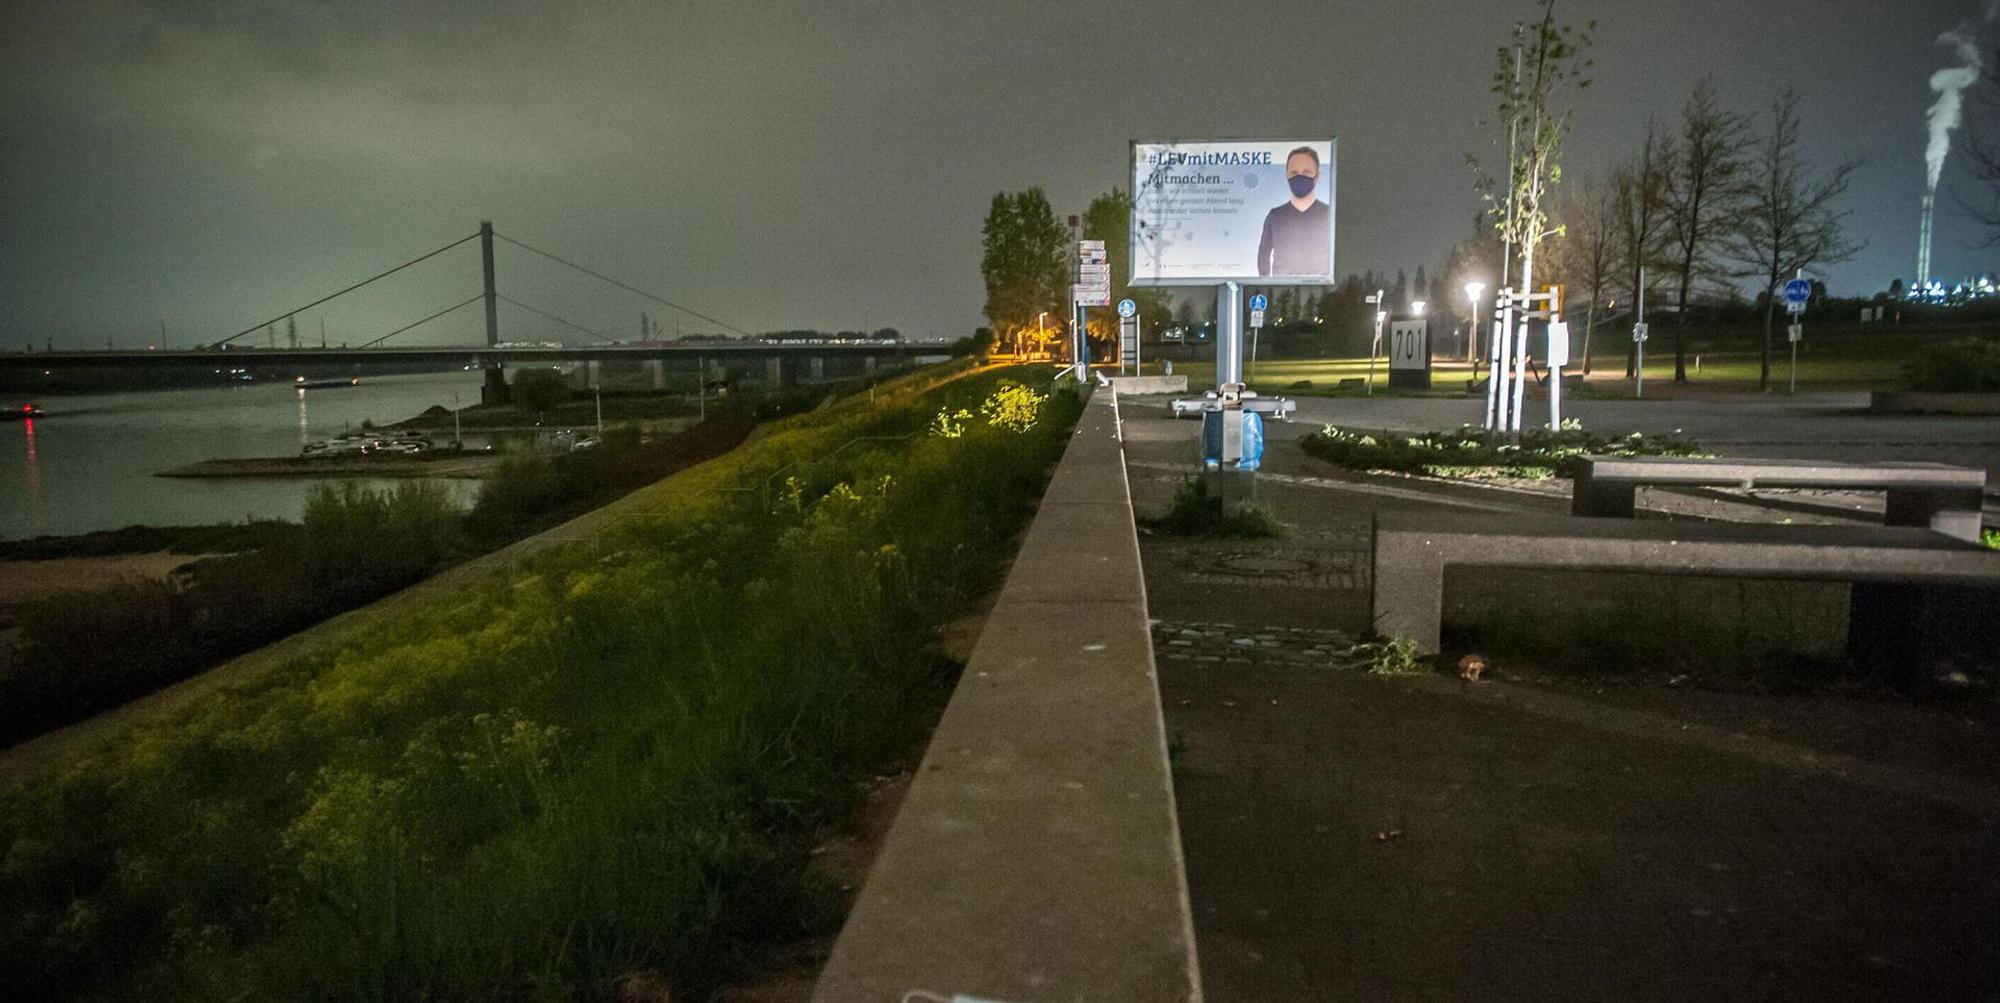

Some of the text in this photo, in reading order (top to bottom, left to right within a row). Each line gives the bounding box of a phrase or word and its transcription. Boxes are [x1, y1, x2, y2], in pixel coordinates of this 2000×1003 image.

[1148, 151, 1272, 166] #LEVmitMASKE
[1147, 172, 1220, 185] Mitmachen
[1396, 327, 1422, 361] 701
